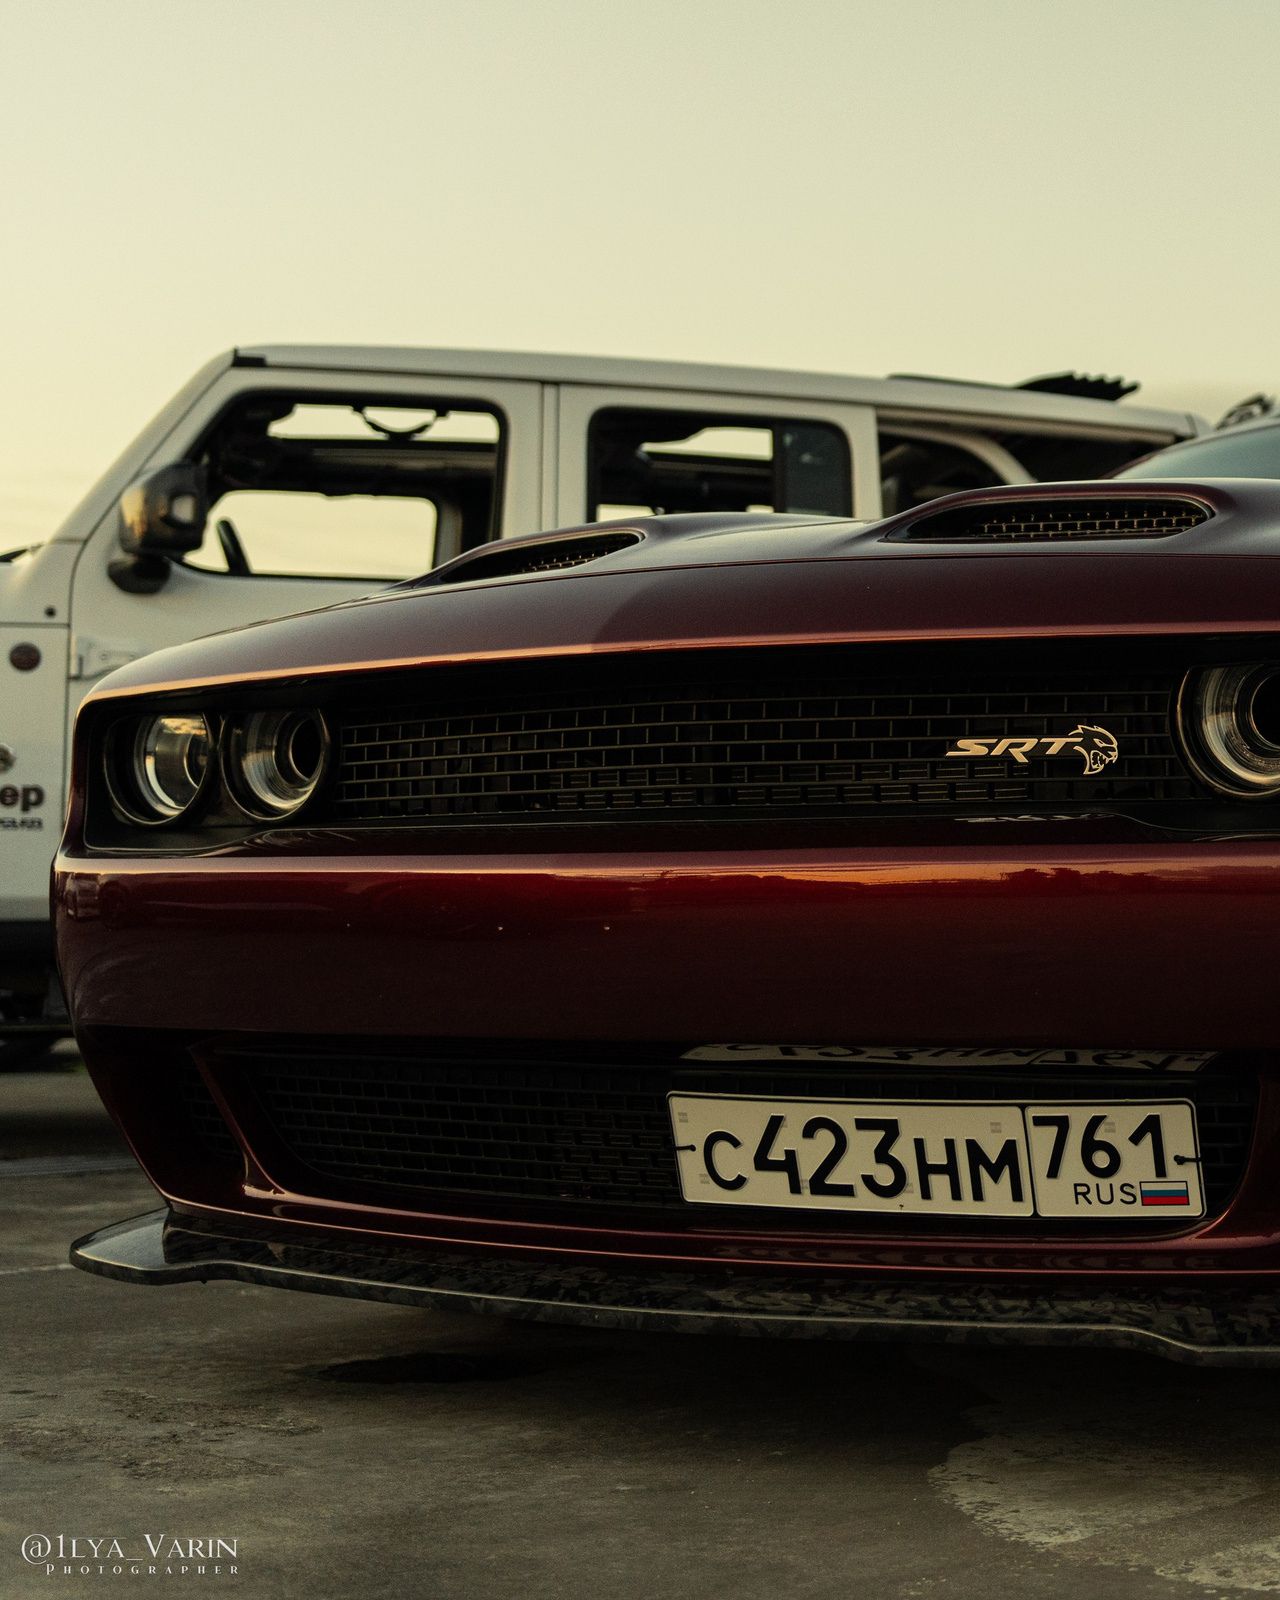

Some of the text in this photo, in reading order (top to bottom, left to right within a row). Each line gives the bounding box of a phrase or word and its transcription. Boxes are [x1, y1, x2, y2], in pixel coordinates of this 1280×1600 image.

[945, 738, 1084, 762] SRT
[1032, 1113, 1168, 1178] 761
[1073, 1182, 1137, 1206] RUS
